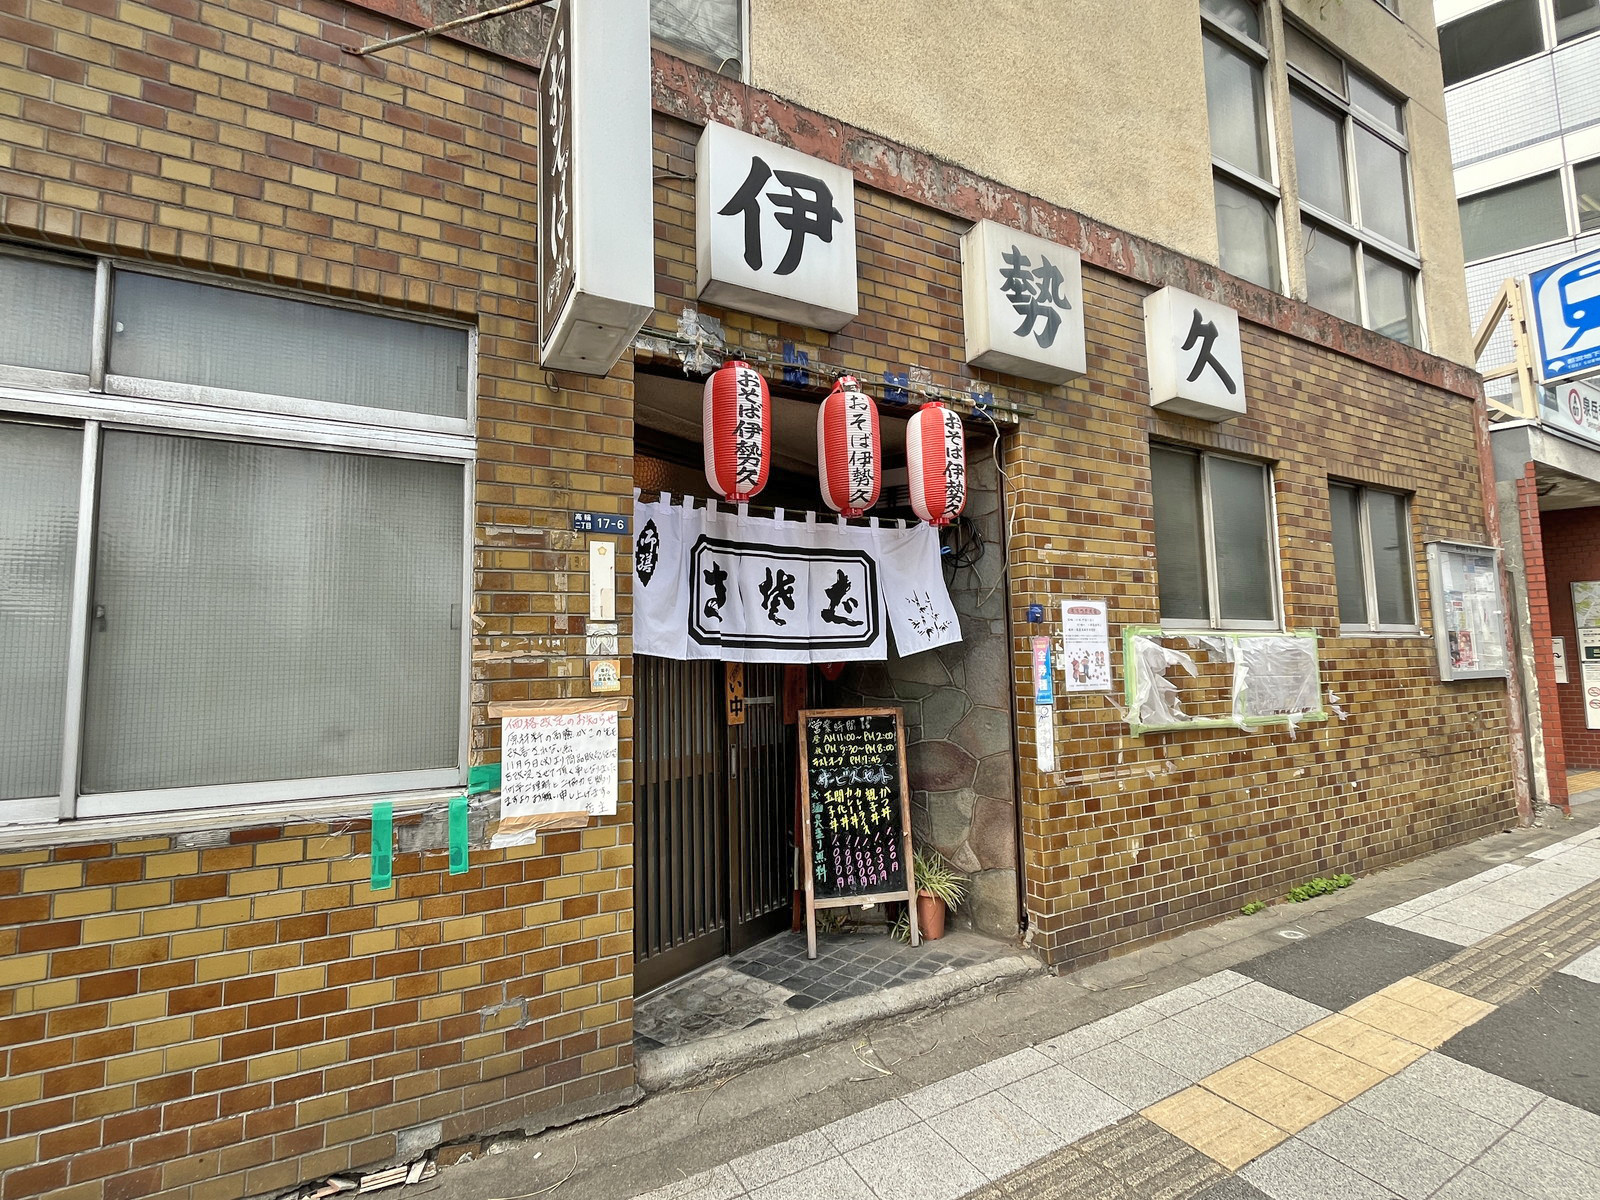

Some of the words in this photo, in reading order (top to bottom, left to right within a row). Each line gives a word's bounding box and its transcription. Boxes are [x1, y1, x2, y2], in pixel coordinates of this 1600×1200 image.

[717, 155, 844, 276] 伊
[998, 244, 1072, 349] 勢
[1181, 307, 1237, 395] 久
[1583, 396, 1600, 421] 泉岳
[732, 370, 763, 486] おそば伊勢久
[848, 394, 873, 503] おそば伊勢久
[943, 412, 965, 516] おそば伊勢久
[574, 513, 592, 521] 高輪
[575, 521, 592, 530] 二丁目
[597, 518, 624, 530] 17-6
[504, 713, 617, 731] 価格改定のお知らせ
